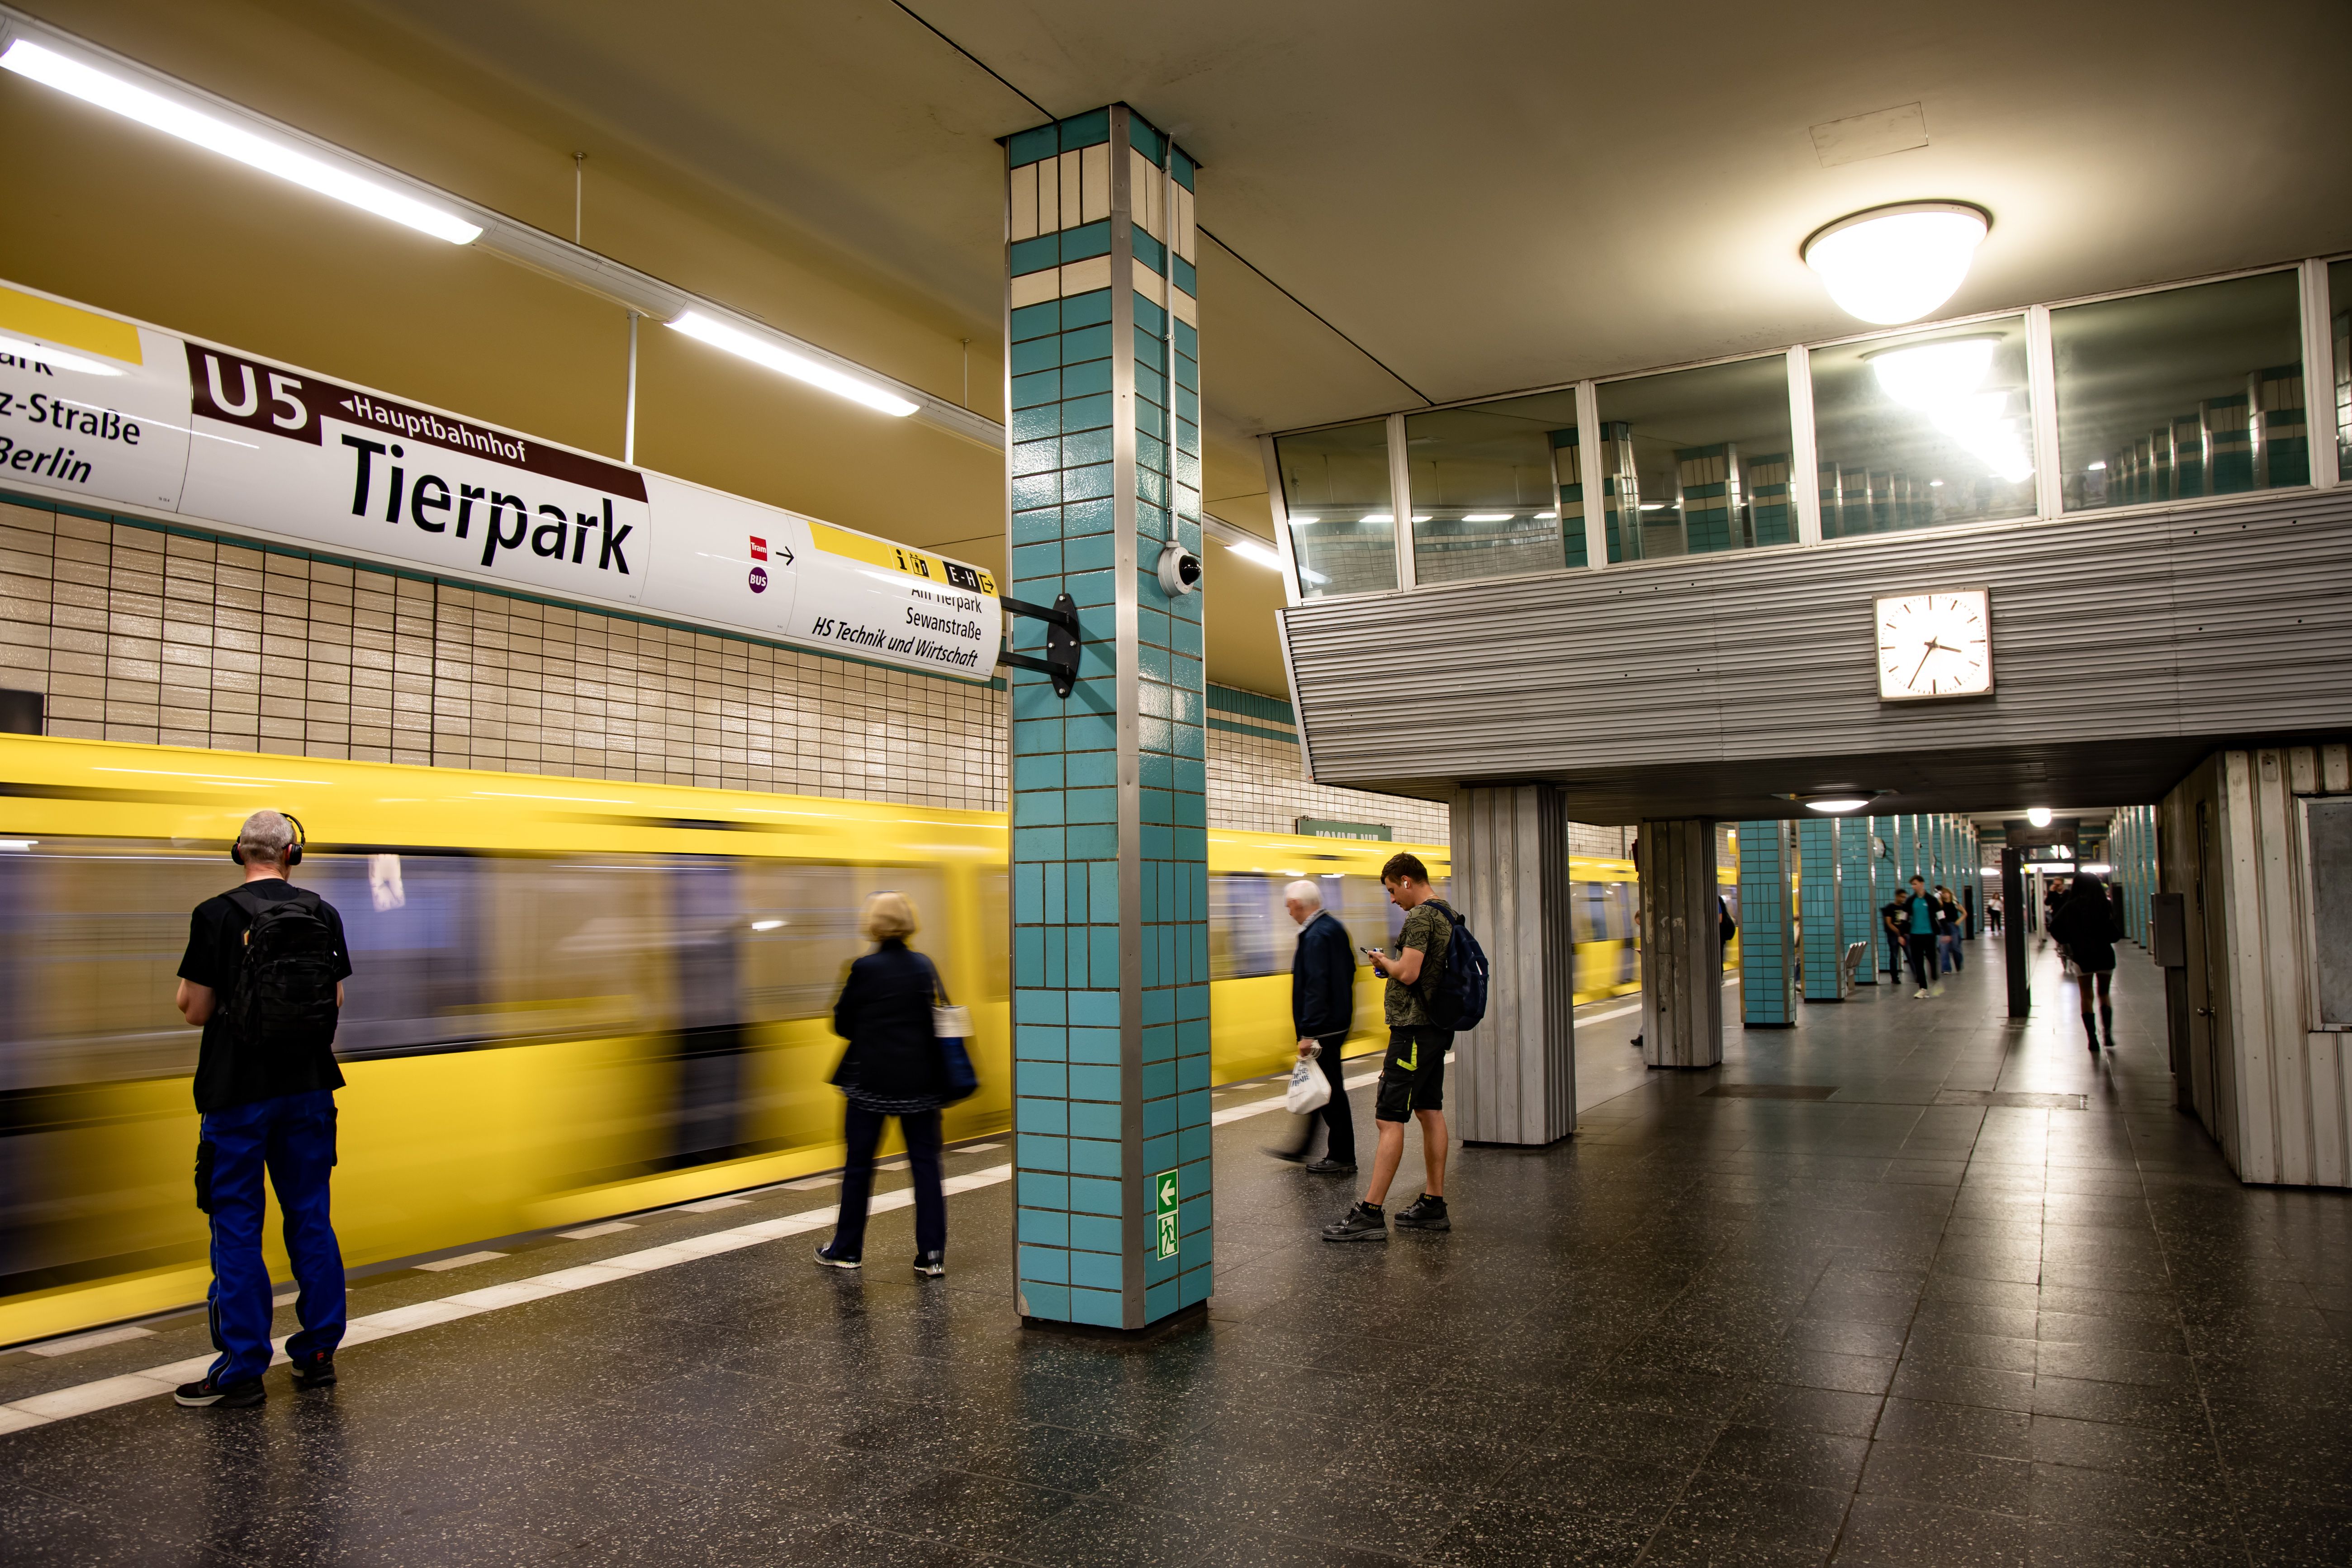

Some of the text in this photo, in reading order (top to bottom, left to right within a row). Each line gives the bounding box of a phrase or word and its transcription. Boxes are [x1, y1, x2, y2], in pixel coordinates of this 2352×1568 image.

[354, 395, 526, 462] Hauptbahnhof
[341, 433, 633, 575] Tierpark
[750, 542, 767, 553] Tram
[750, 574, 767, 587] BUS
[812, 617, 978, 667] HS Technik und Wirtschaft
[906, 606, 981, 640] Sewanstraße
